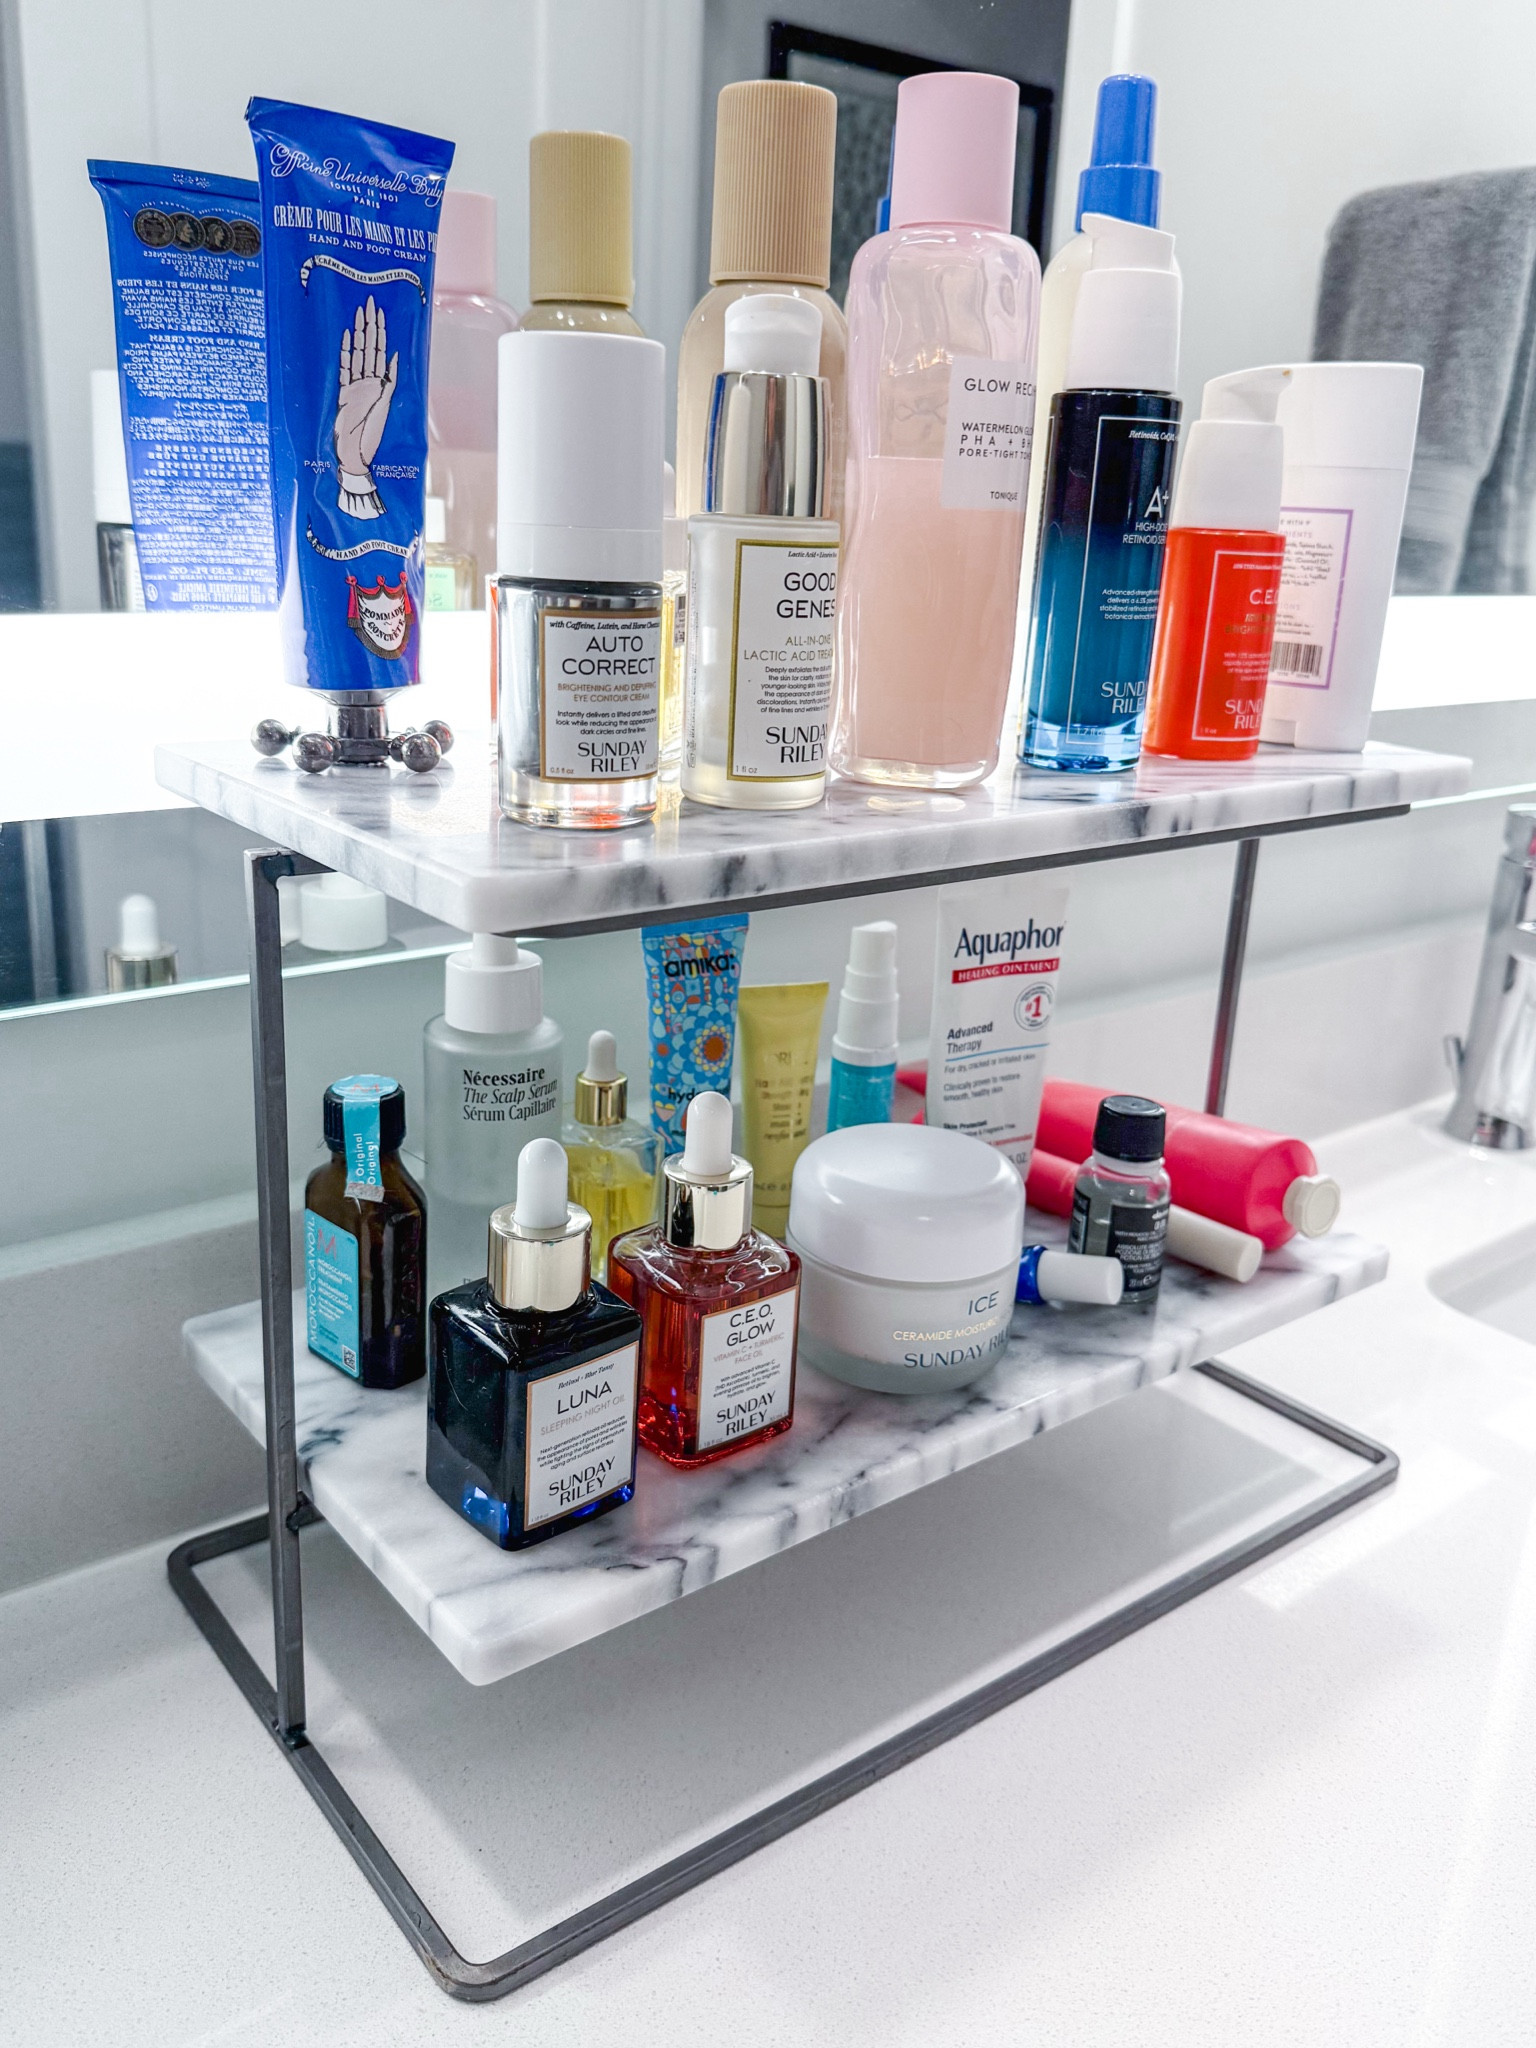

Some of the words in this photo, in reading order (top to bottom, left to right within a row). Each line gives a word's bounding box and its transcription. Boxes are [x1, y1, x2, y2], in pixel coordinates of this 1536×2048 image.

[270, 143, 331, 178] Officine
[323, 158, 409, 193] Universelle
[409, 174, 443, 208] Buly
[354, 195, 381, 209] PARIS
[274, 202, 313, 229] CRÈME
[316, 209, 342, 234] POUR
[344, 214, 363, 238] LES
[364, 220, 393, 245] MAINS
[394, 226, 406, 248] ET
[407, 230, 426, 251] LES
[309, 233, 340, 246] HAND
[343, 239, 363, 250] AND
[366, 244, 391, 256] FOOT
[394, 250, 427, 263] CREAM
[318, 257, 340, 270] CRÈME
[340, 266, 356, 279] POUR
[356, 274, 367, 282] LES
[368, 274, 386, 283] MAINS
[394, 271, 404, 279] LES
[964, 378, 1010, 392] GLOW
[962, 422, 1023, 435] WATERMELON
[959, 448, 1018, 460] PORE-TIGHT
[304, 460, 332, 468] PARIS
[372, 464, 420, 473] FABRICATION
[376, 471, 417, 480] FRANÇAISE
[990, 491, 1018, 502] TONIQUE
[1144, 486, 1169, 518] A+
[1122, 534, 1157, 544] RETINOID
[336, 548, 358, 558] HAND
[359, 543, 370, 554] AND
[372, 541, 386, 550] FOOT
[784, 572, 836, 592] GOOD
[364, 605, 404, 622] POMMADE
[776, 599, 835, 618] GENES
[368, 620, 405, 642] CONCRÈTE
[566, 620, 595, 630] Caffeine,
[597, 622, 619, 630] Lutein,
[621, 622, 632, 630] and
[586, 636, 644, 652] AUTO
[786, 635, 831, 646] ALL-IN-ONE
[744, 650, 787, 661] LACTIC
[790, 650, 816, 661] ACID
[562, 658, 656, 675] CORRECT
[765, 666, 787, 674] Deeply
[558, 683, 612, 692] BRIGHTENING
[614, 682, 630, 691] AND
[1101, 681, 1145, 698] SUND
[590, 694, 628, 702] CONTOUR
[1112, 698, 1144, 714] RILE
[1225, 699, 1263, 715] SUND
[558, 710, 584, 718] Instantly
[578, 740, 647, 757] SUNDAY
[780, 745, 826, 763] RILEY
[592, 756, 640, 772] RILEY
[954, 918, 1064, 965] Aquaphor
[664, 953, 735, 977] amika:
[958, 966, 1000, 982] HEALING
[1002, 960, 1058, 974] OINTMENT
[1025, 995, 1042, 1018] #1
[947, 1022, 994, 1040] Advanced
[946, 1039, 982, 1054] Therapy
[463, 1068, 545, 1086] Nécessaire
[464, 1087, 488, 1104] The
[490, 1088, 526, 1104] Scalp
[528, 1079, 558, 1100] Serum
[464, 1105, 505, 1122] Sérum
[508, 1096, 557, 1121] Capillaire
[354, 1133, 366, 1176] Original
[306, 1216, 318, 1344] MOROCCANOIL
[968, 1290, 1000, 1315] ICE
[730, 1304, 773, 1328] C.E.O.
[726, 1319, 775, 1346] GLOW
[893, 1330, 952, 1342] CERAMIDE
[714, 1348, 740, 1362] VITAMIN
[742, 1346, 747, 1354] C
[754, 1332, 784, 1348] TURMERIC
[904, 1342, 986, 1368] SUNDAY
[734, 1355, 752, 1364] FACE
[753, 1350, 763, 1359] OIL
[558, 1375, 580, 1390] Retinol
[584, 1369, 598, 1380] Blue
[599, 1364, 615, 1374] Tansy
[557, 1381, 612, 1415] LUNA
[716, 1390, 776, 1424] SUNDAY
[541, 1413, 583, 1436] SLEEPING
[584, 1400, 611, 1418] NIGHT
[612, 1394, 625, 1404] OIL
[726, 1409, 768, 1436] RILEY
[546, 1443, 579, 1460] appearance
[549, 1456, 615, 1496] SUNDAY
[560, 1474, 606, 1506] RILEY
